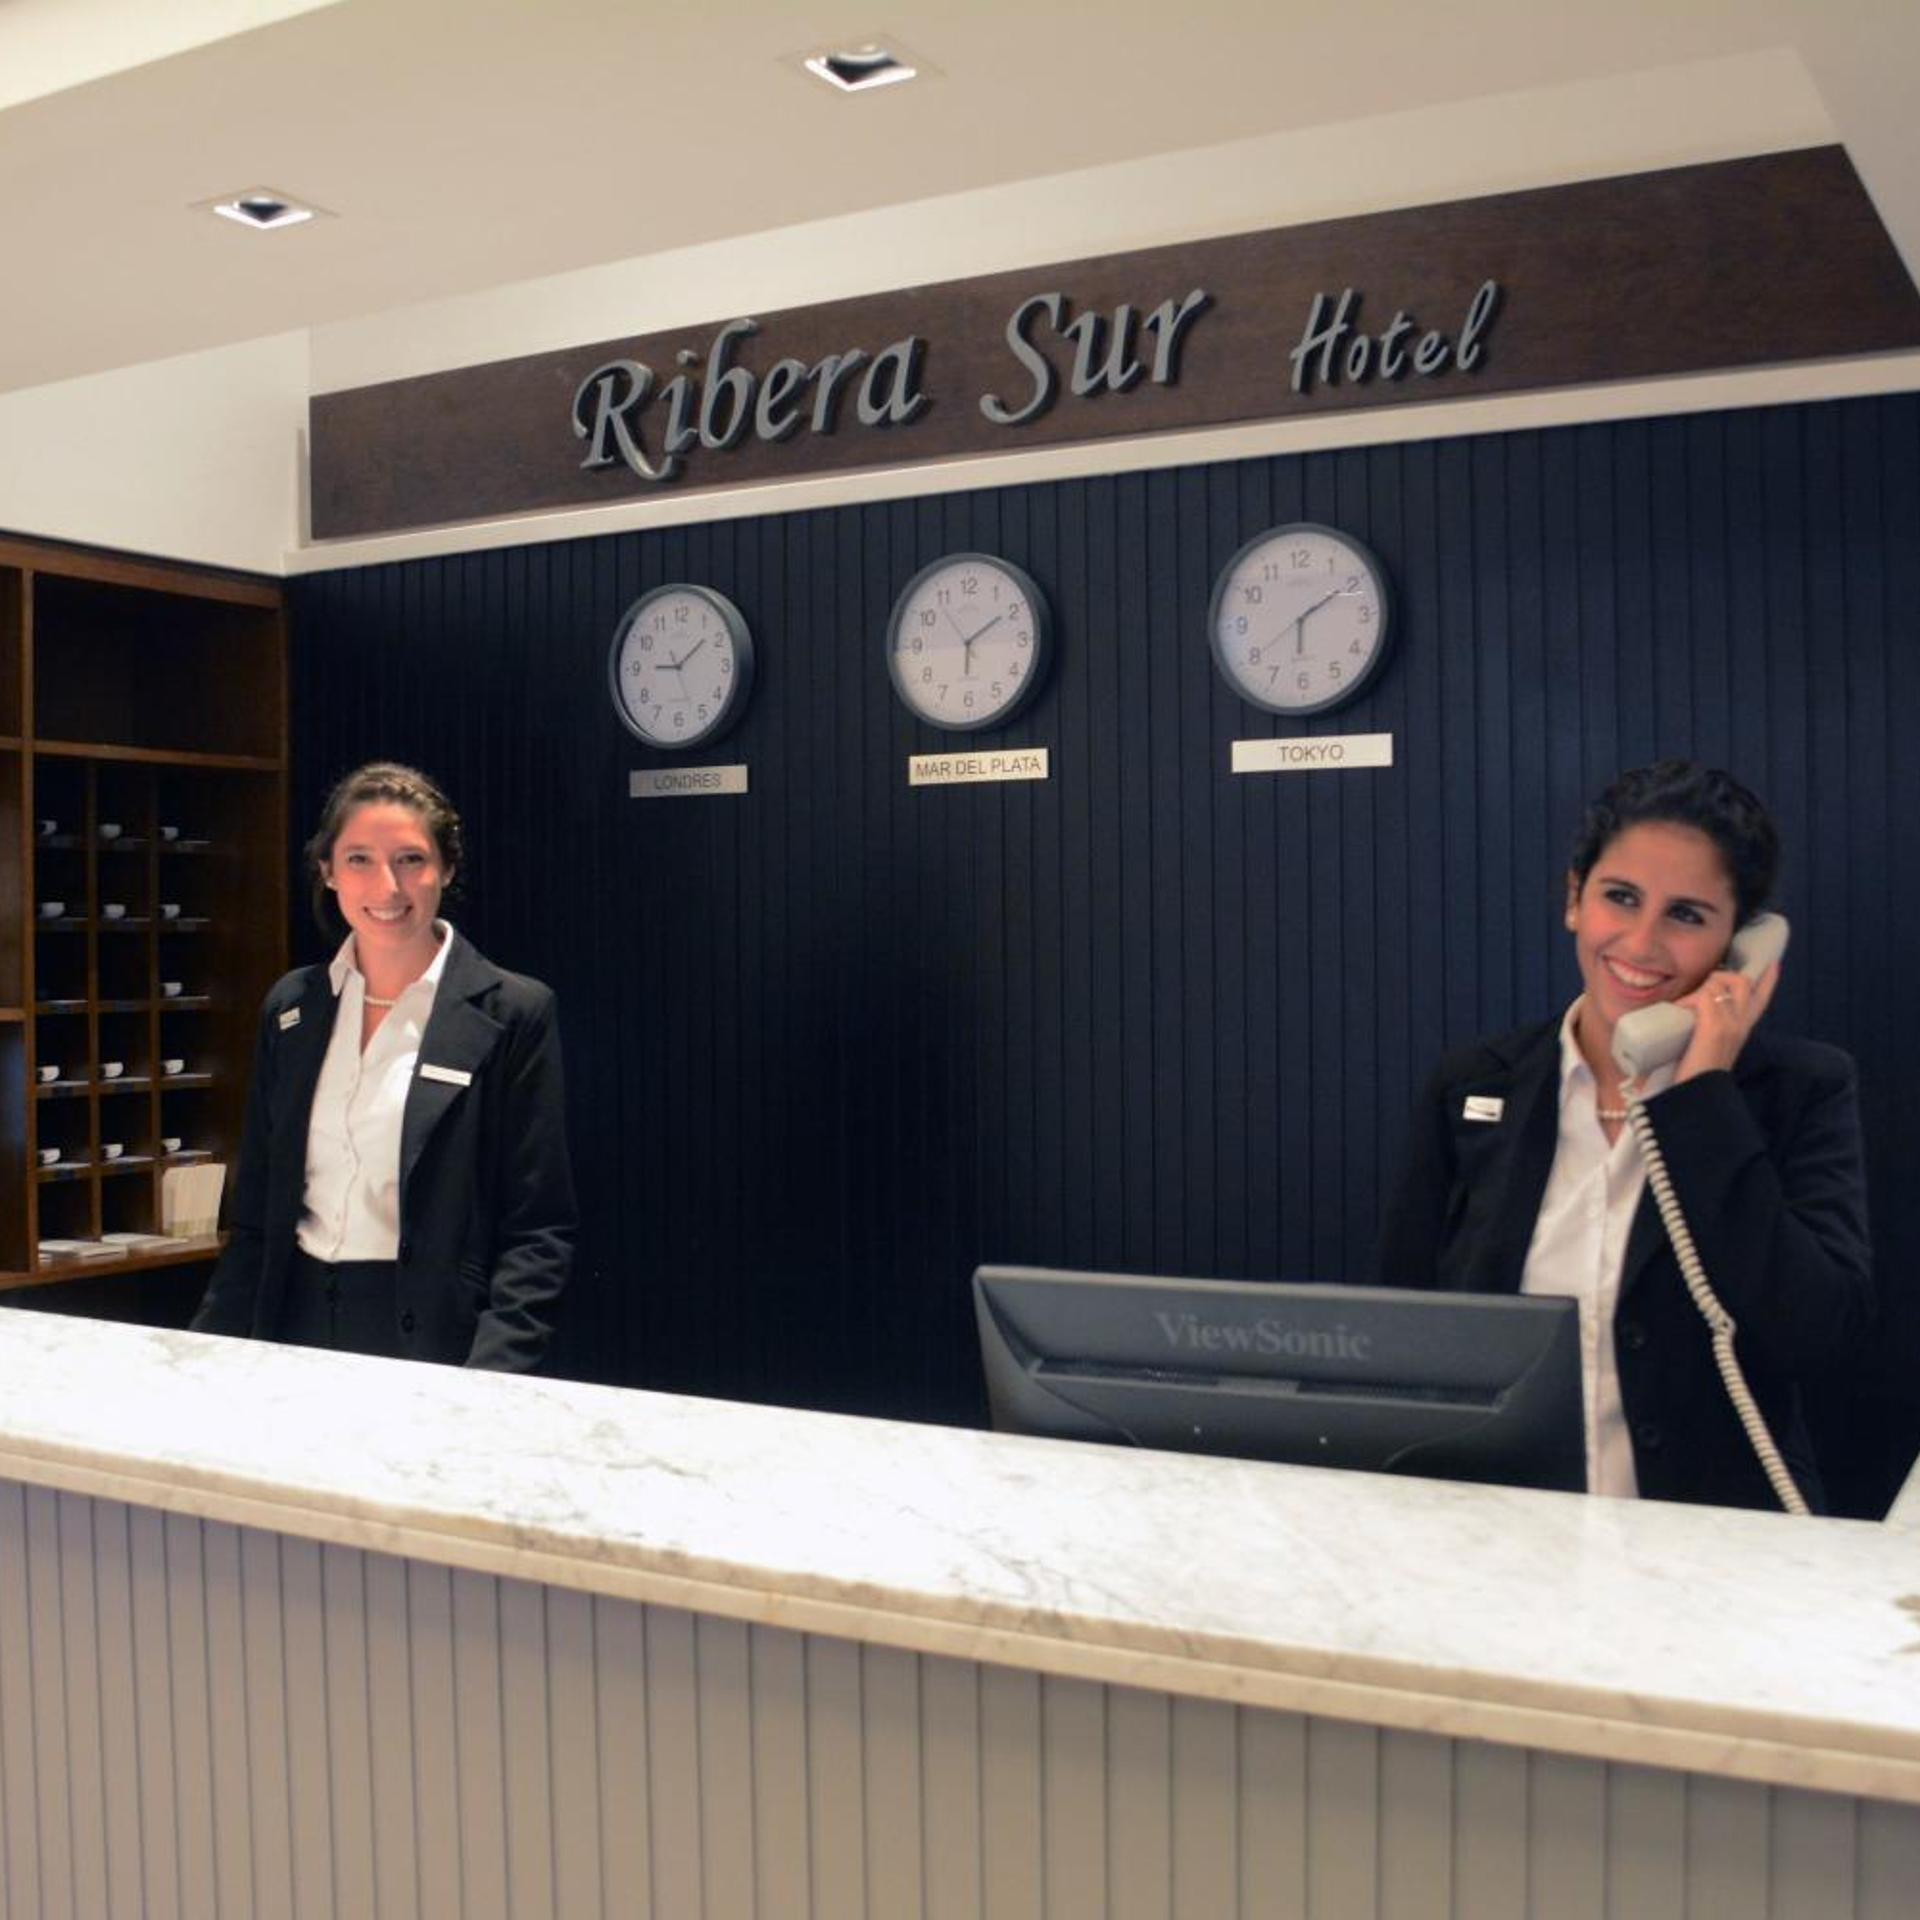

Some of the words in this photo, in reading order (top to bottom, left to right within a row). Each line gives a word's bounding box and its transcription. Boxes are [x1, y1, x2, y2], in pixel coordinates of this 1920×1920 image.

[573, 318, 927, 481] Ribera
[980, 290, 1206, 424] Sur
[1290, 279, 1498, 391] Hotel
[1291, 550, 1311, 569] 12
[1263, 564, 1279, 581] 11
[960, 577, 978, 594] 12
[1346, 576, 1360, 593] 2
[937, 589, 950, 605] 11
[1244, 585, 1262, 604] 10
[675, 606, 689, 623] 12
[920, 609, 936, 626] 10
[1008, 603, 1019, 620] 2
[1359, 606, 1370, 624] 3
[655, 615, 666, 631] 11
[1236, 617, 1248, 635] 9
[640, 635, 653, 651] 10
[714, 632, 724, 648] 2
[912, 637, 922, 654] 9
[1016, 631, 1028, 648] 3
[1349, 639, 1360, 654] 4
[1249, 647, 1261, 665] 8
[632, 660, 641, 676] 9
[721, 658, 731, 673] 3
[1008, 662, 1019, 676] 4
[1329, 661, 1341, 679] 5
[922, 666, 932, 683] 8
[1268, 666, 1280, 684] 7
[1297, 672, 1309, 690] 6
[640, 688, 649, 703] 8
[712, 686, 722, 701] 4
[937, 685, 948, 700] 7
[991, 681, 1002, 698] 5
[963, 691, 973, 707] 6
[653, 704, 662, 720] 7
[673, 711, 684, 727] 6
[698, 704, 708, 720] 5
[1277, 744, 1344, 762] TOKYO
[916, 761, 951, 777] MAR
[956, 760, 987, 774] DEL
[991, 756, 1041, 772] PLATA
[655, 772, 721, 790] LONDRES
[1155, 1311, 1372, 1361] ViewSonic
